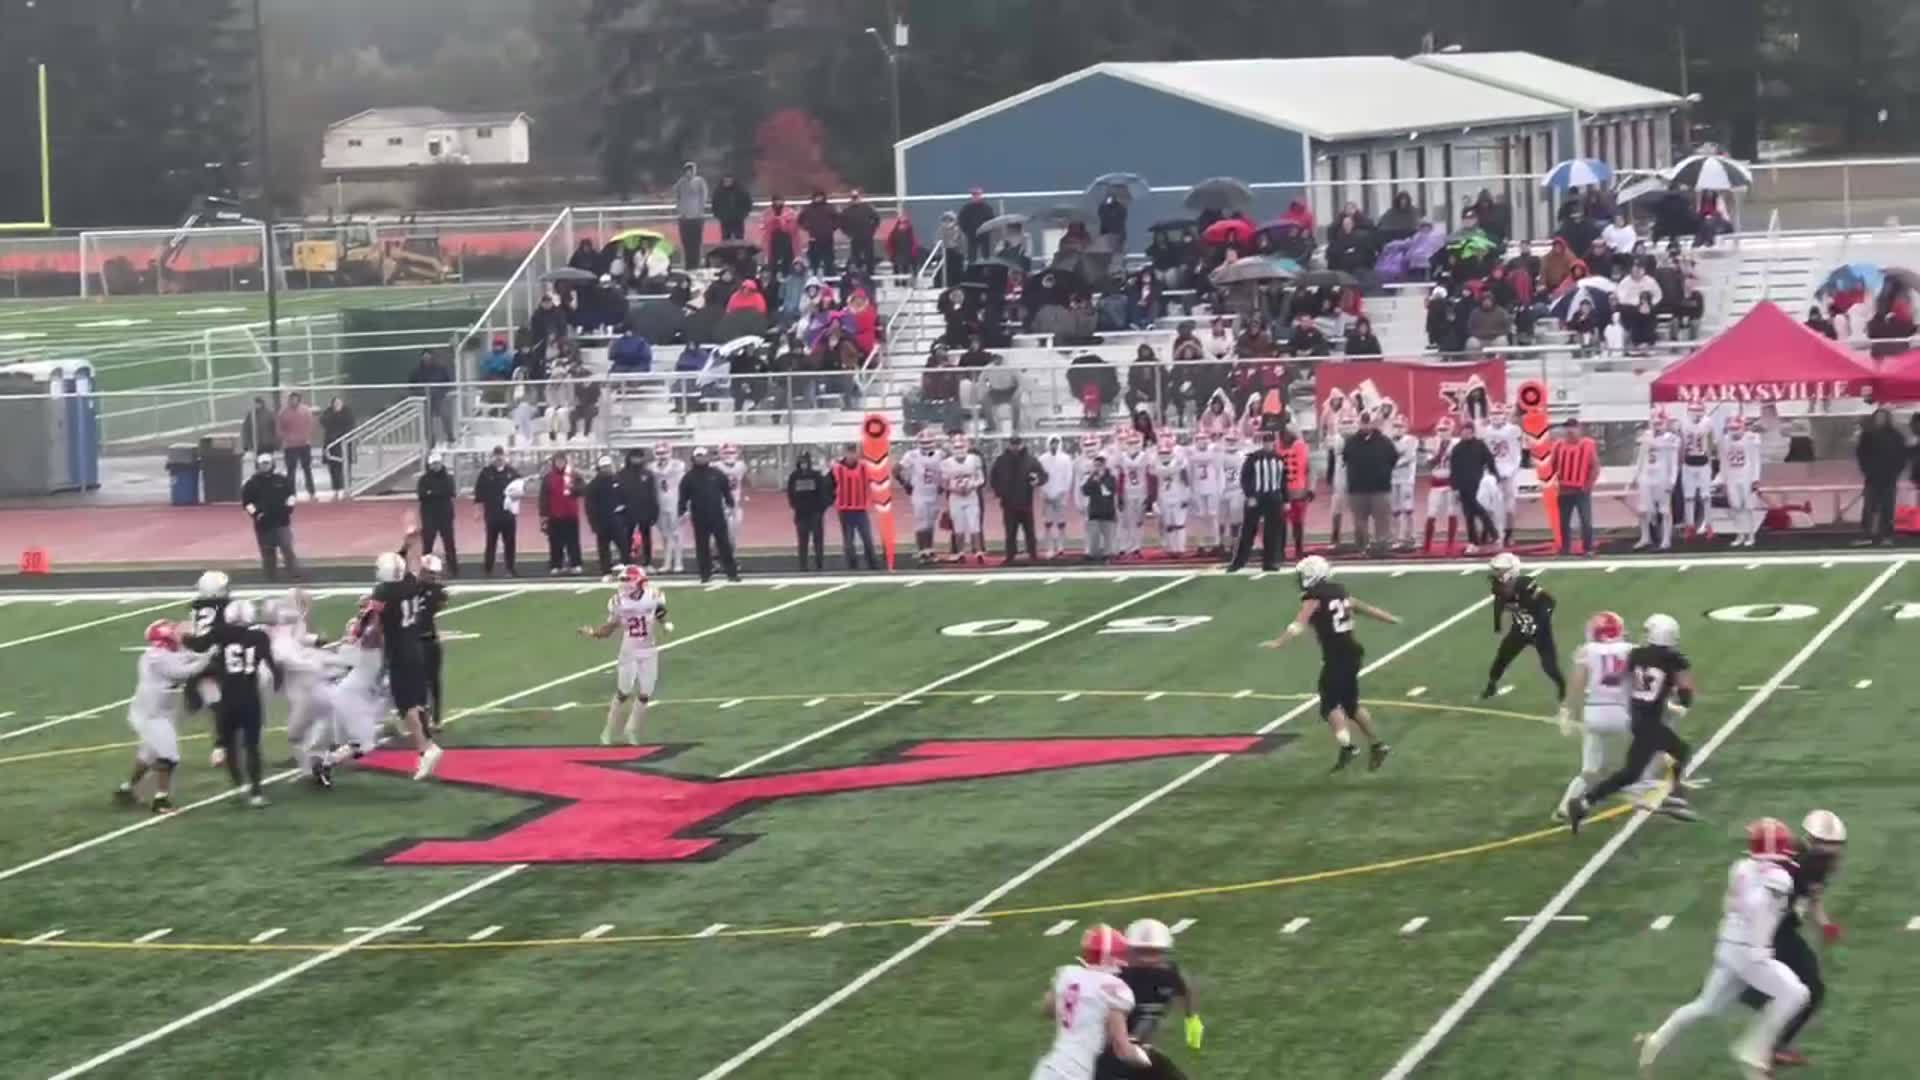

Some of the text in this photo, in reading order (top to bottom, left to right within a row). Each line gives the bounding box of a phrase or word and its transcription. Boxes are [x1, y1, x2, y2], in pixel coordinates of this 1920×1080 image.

[1677, 381, 1848, 400] MARYSVILLE
[627, 615, 648, 637] 21
[224, 643, 256, 674] 61
